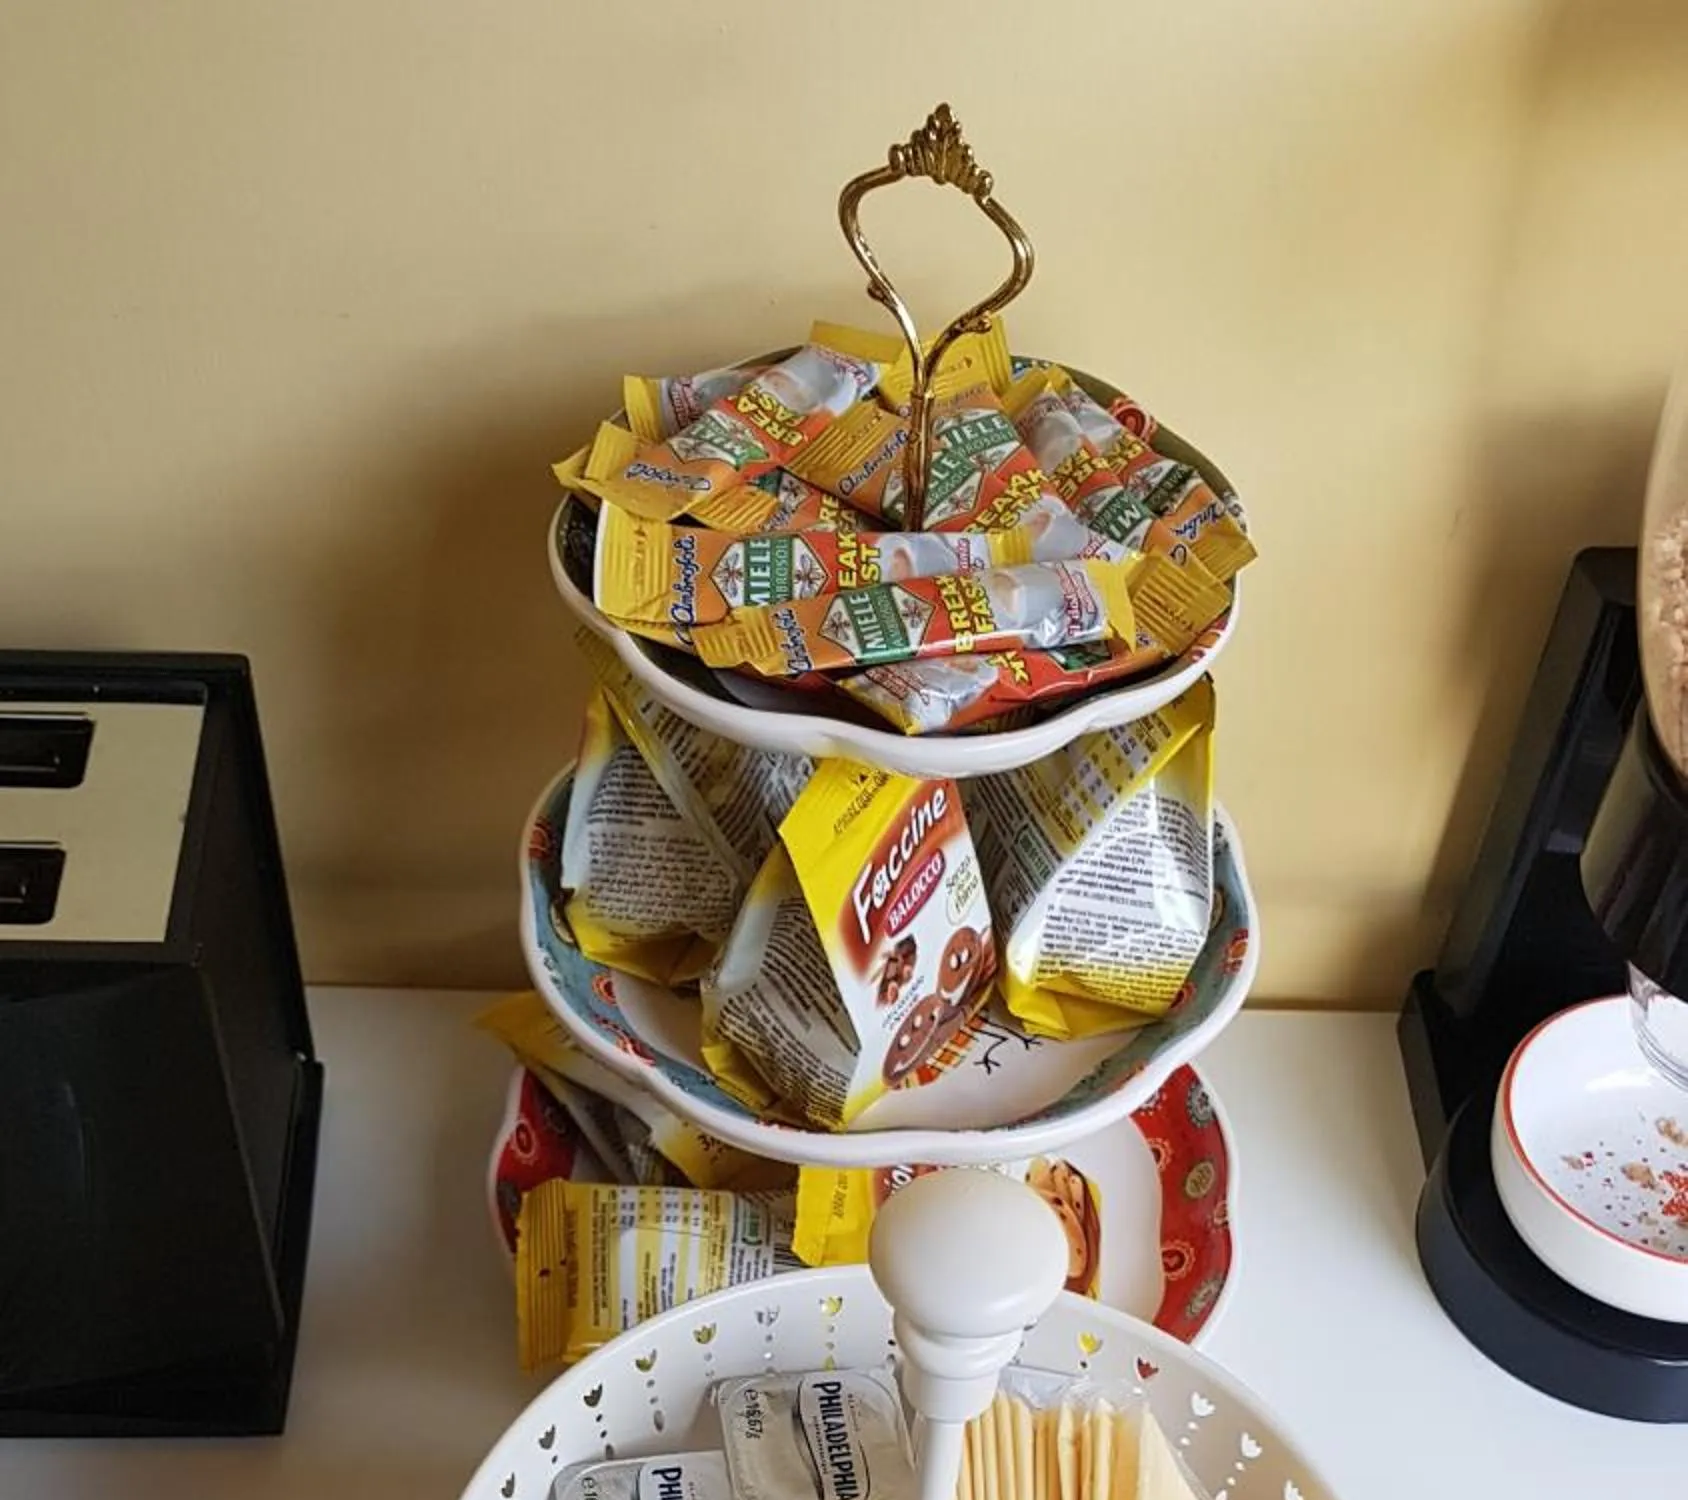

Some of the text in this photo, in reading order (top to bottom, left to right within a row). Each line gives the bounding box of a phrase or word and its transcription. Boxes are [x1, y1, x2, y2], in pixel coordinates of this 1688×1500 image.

[838, 530, 859, 589] EAK
[859, 544, 880, 583] ST
[850, 592, 887, 650] MIELE
[852, 787, 949, 945] Faccine
[888, 855, 942, 931] BALOCCO
